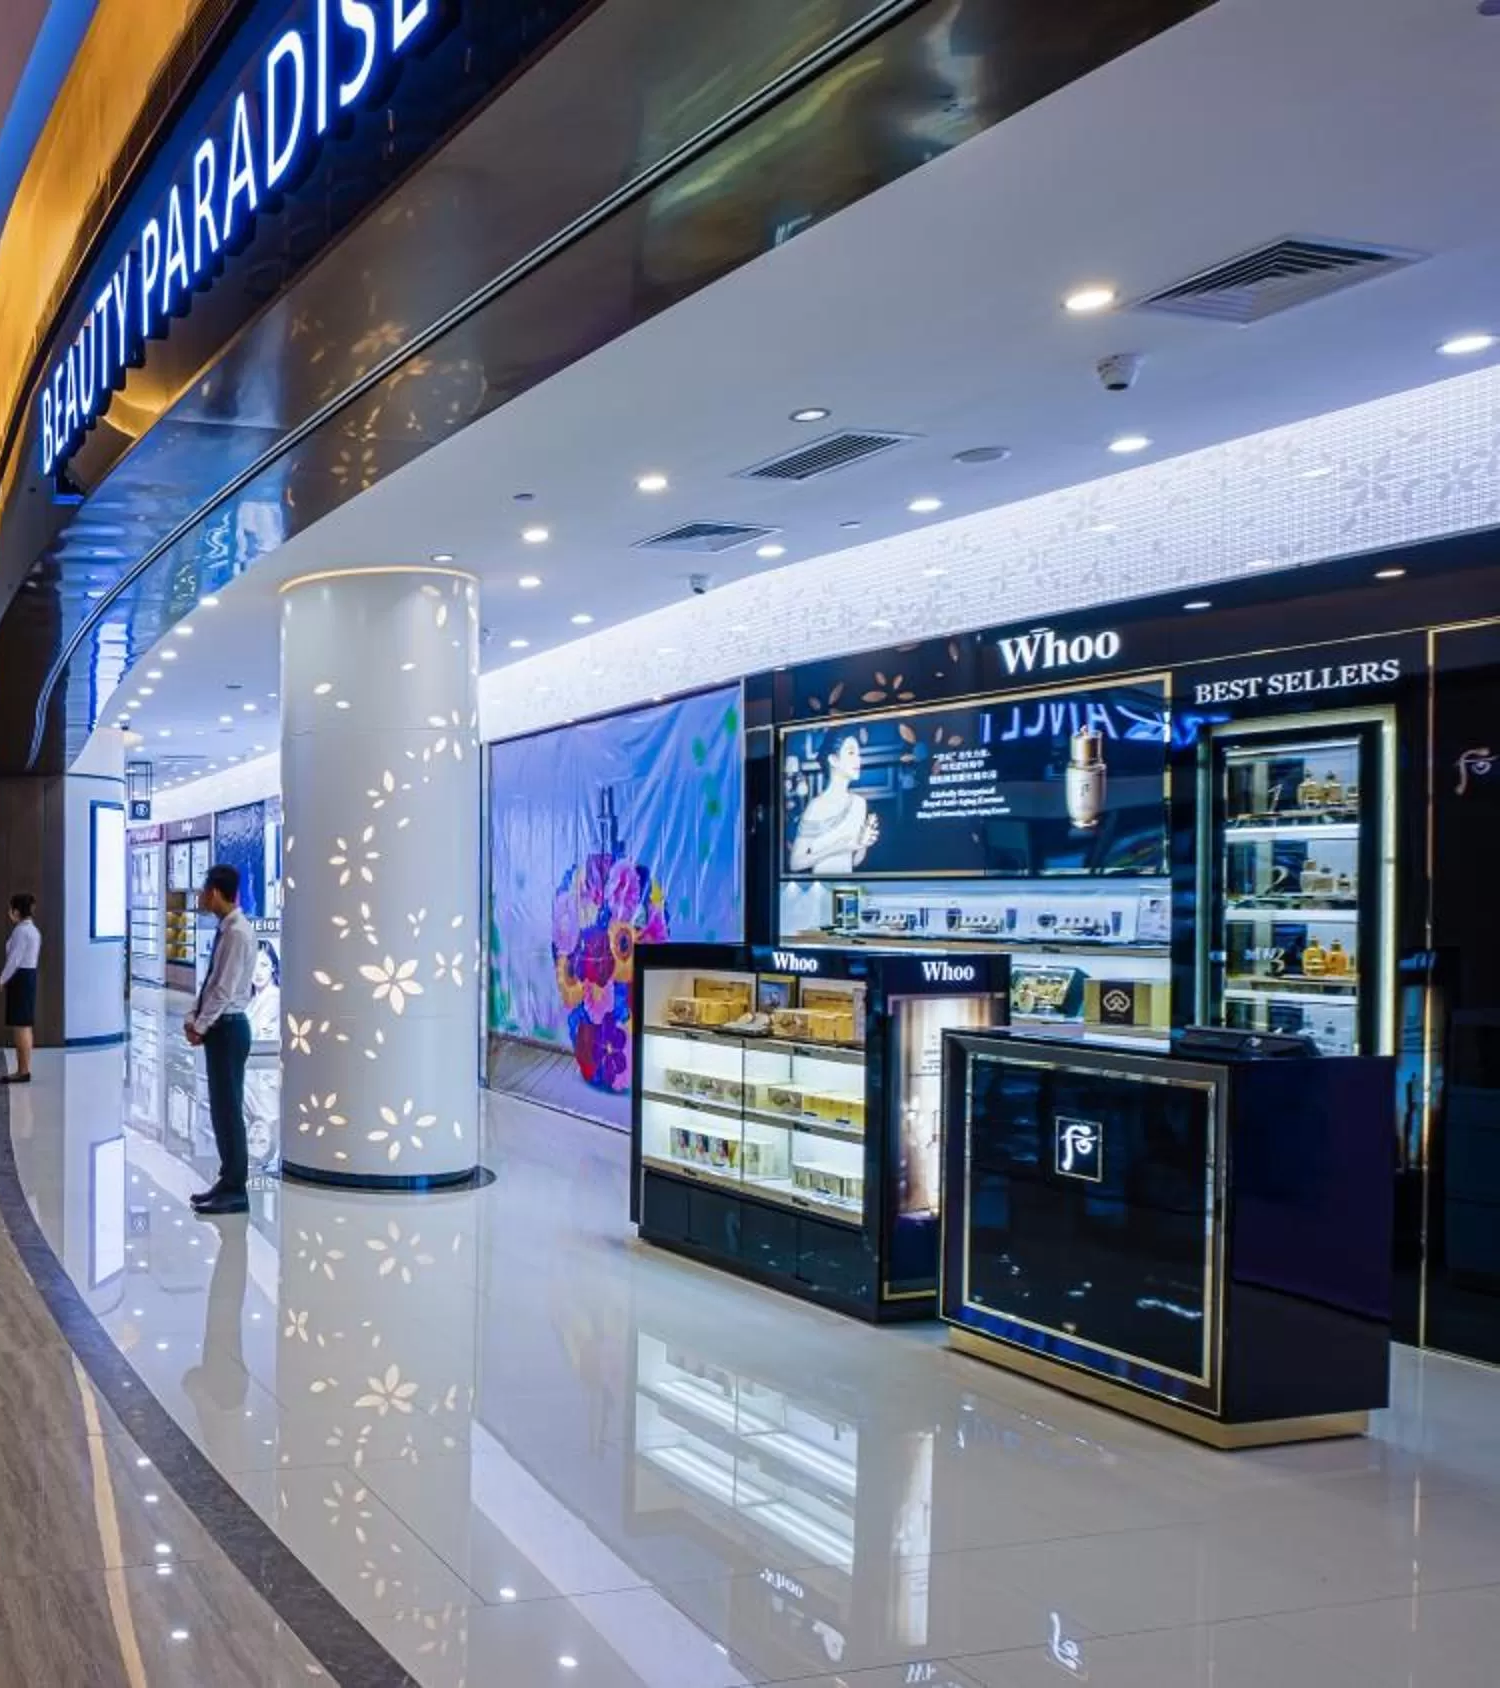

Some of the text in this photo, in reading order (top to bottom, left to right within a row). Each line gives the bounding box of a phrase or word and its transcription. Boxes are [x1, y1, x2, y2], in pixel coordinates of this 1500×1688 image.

[42, 0, 430, 476] BEAUTY PARADIS
[998, 628, 1121, 674] Whoo
[1194, 659, 1401, 705] BEST SELLERS
[247, 919, 281, 931] NEIGE
[772, 951, 819, 972] Whoo
[921, 961, 975, 981] Whoo
